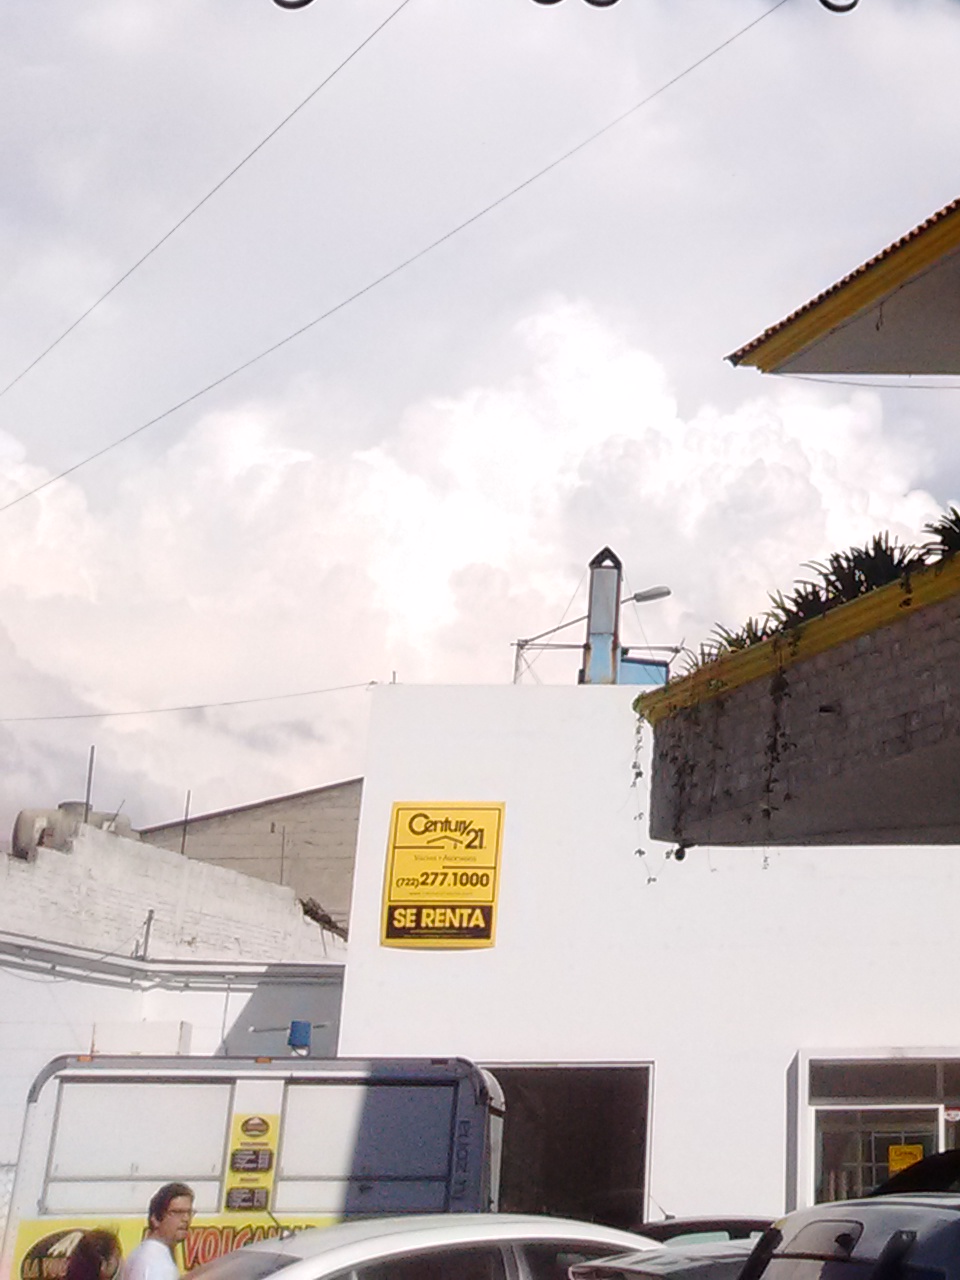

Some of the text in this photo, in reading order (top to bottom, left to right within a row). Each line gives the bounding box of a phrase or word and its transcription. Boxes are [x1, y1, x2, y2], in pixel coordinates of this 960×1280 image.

[408, 812, 474, 837] Century
[464, 827, 485, 850] 21
[392, 907, 486, 928] SE RENTA
